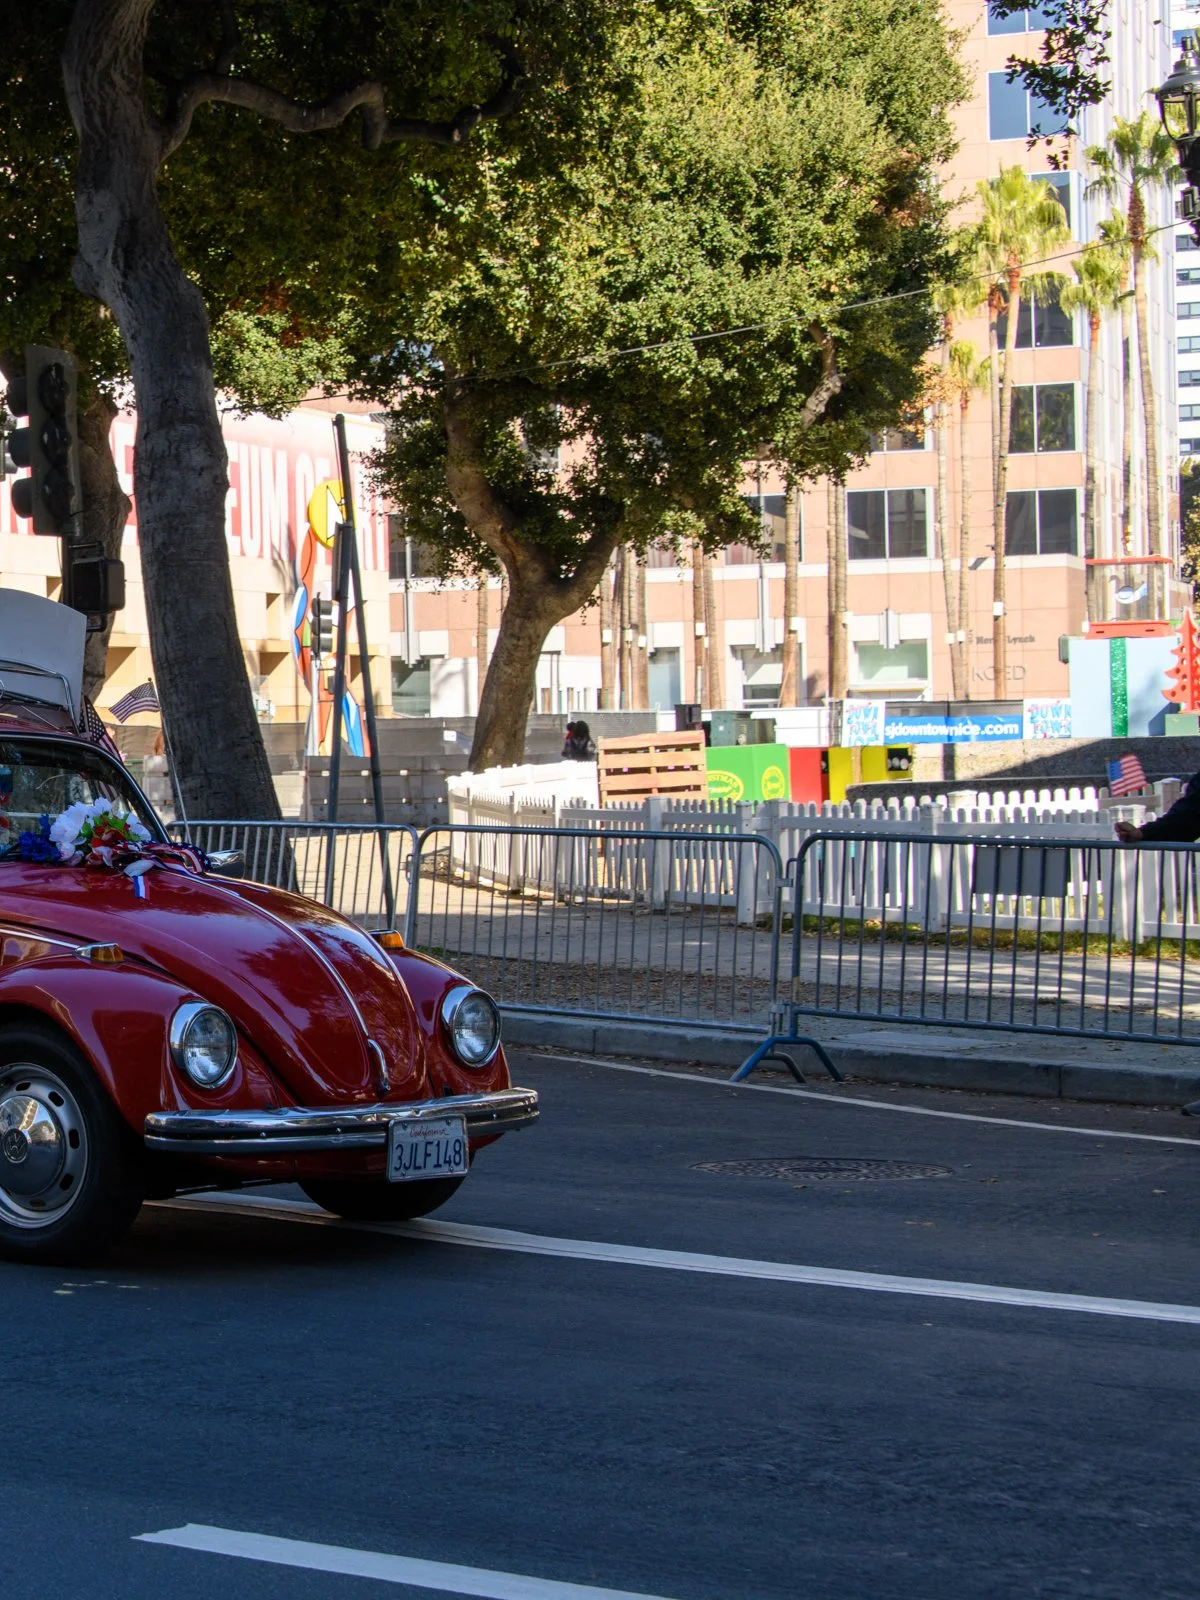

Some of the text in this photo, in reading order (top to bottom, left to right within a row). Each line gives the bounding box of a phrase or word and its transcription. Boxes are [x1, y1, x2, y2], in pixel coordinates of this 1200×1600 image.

[885, 721, 1019, 739] sjdowntownice.com
[410, 1125, 449, 1139] California
[394, 1138, 462, 1171] 3JLF148
